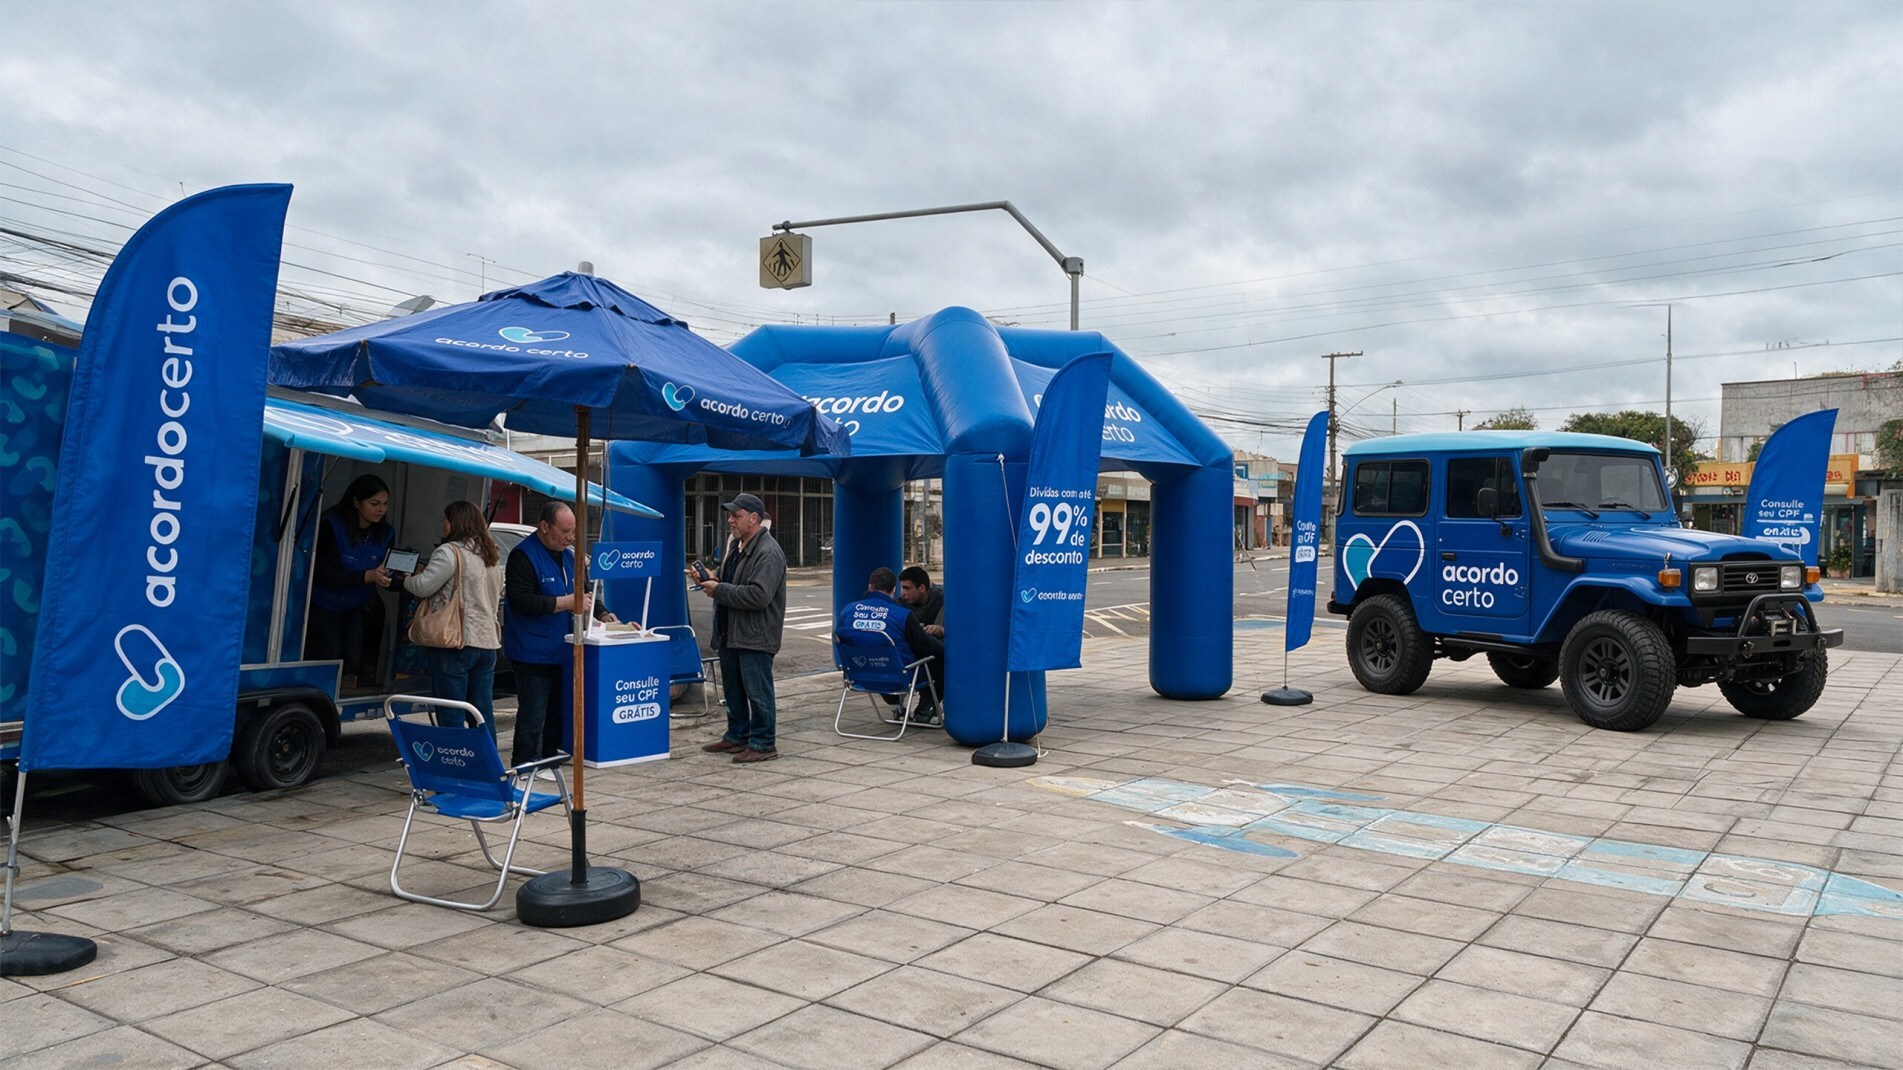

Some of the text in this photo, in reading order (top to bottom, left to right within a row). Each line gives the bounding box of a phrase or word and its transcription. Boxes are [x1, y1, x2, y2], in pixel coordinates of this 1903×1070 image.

[434, 337, 589, 359] acordo certo
[700, 397, 785, 426] acordo certo
[144, 276, 198, 608] acordocerto
[1778, 509, 1801, 518] CPF
[1070, 530, 1085, 547] de
[1025, 549, 1083, 565] desconto
[1441, 562, 1519, 586] acordo
[1441, 586, 1495, 609] certo
[615, 688, 659, 704] seu CPF
[619, 704, 656, 720] GRÁTIS
